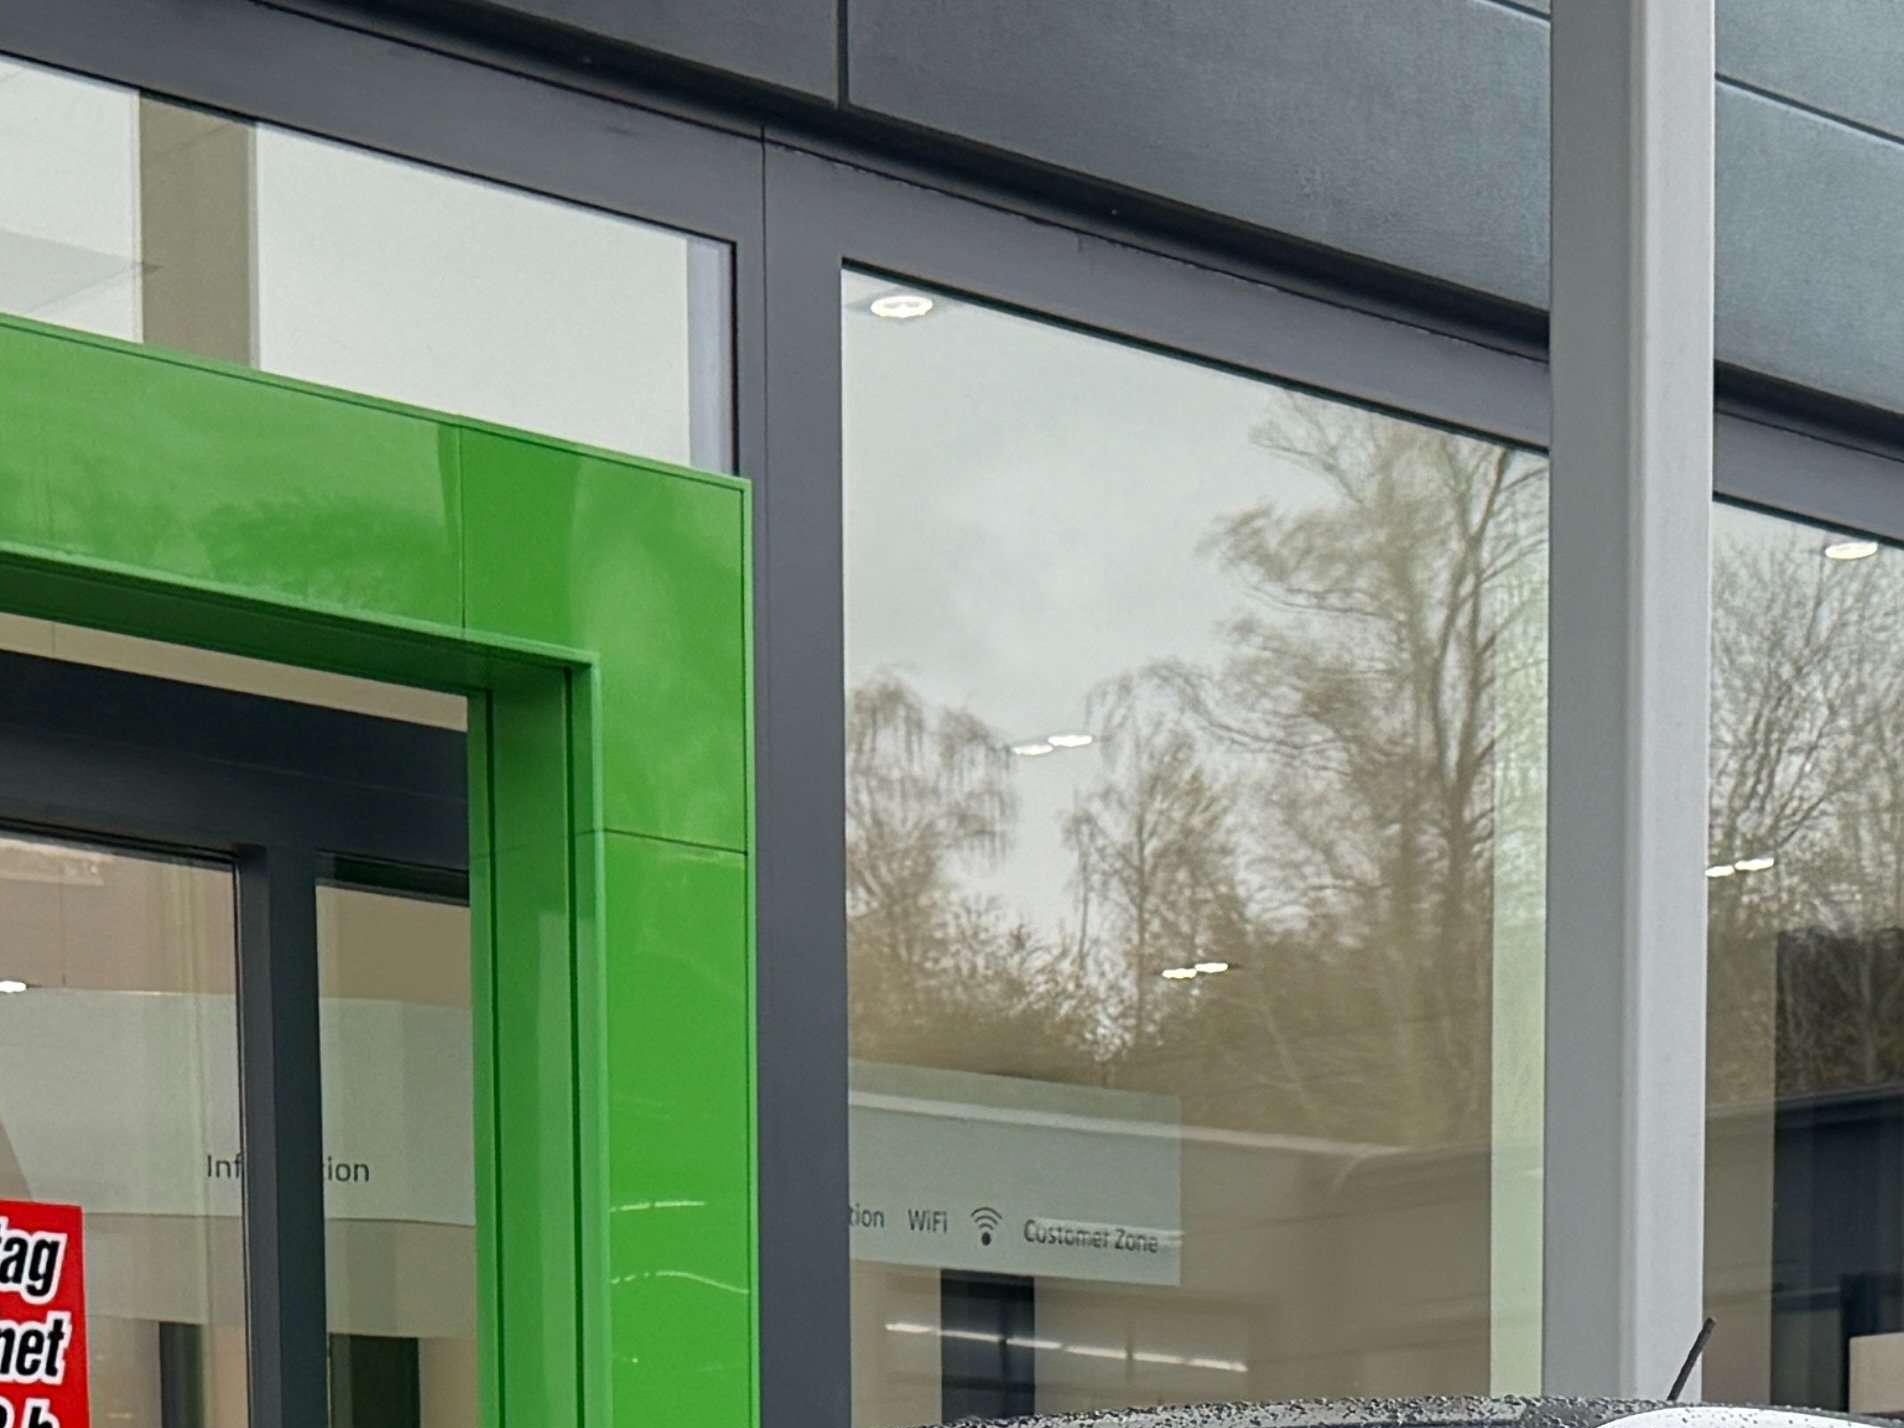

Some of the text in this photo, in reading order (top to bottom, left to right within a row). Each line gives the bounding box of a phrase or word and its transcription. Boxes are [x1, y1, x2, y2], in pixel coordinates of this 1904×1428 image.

[907, 1208, 948, 1233] WiFi
[1023, 1219, 1108, 1250] Customer
[1114, 1228, 1159, 1254] Zone
